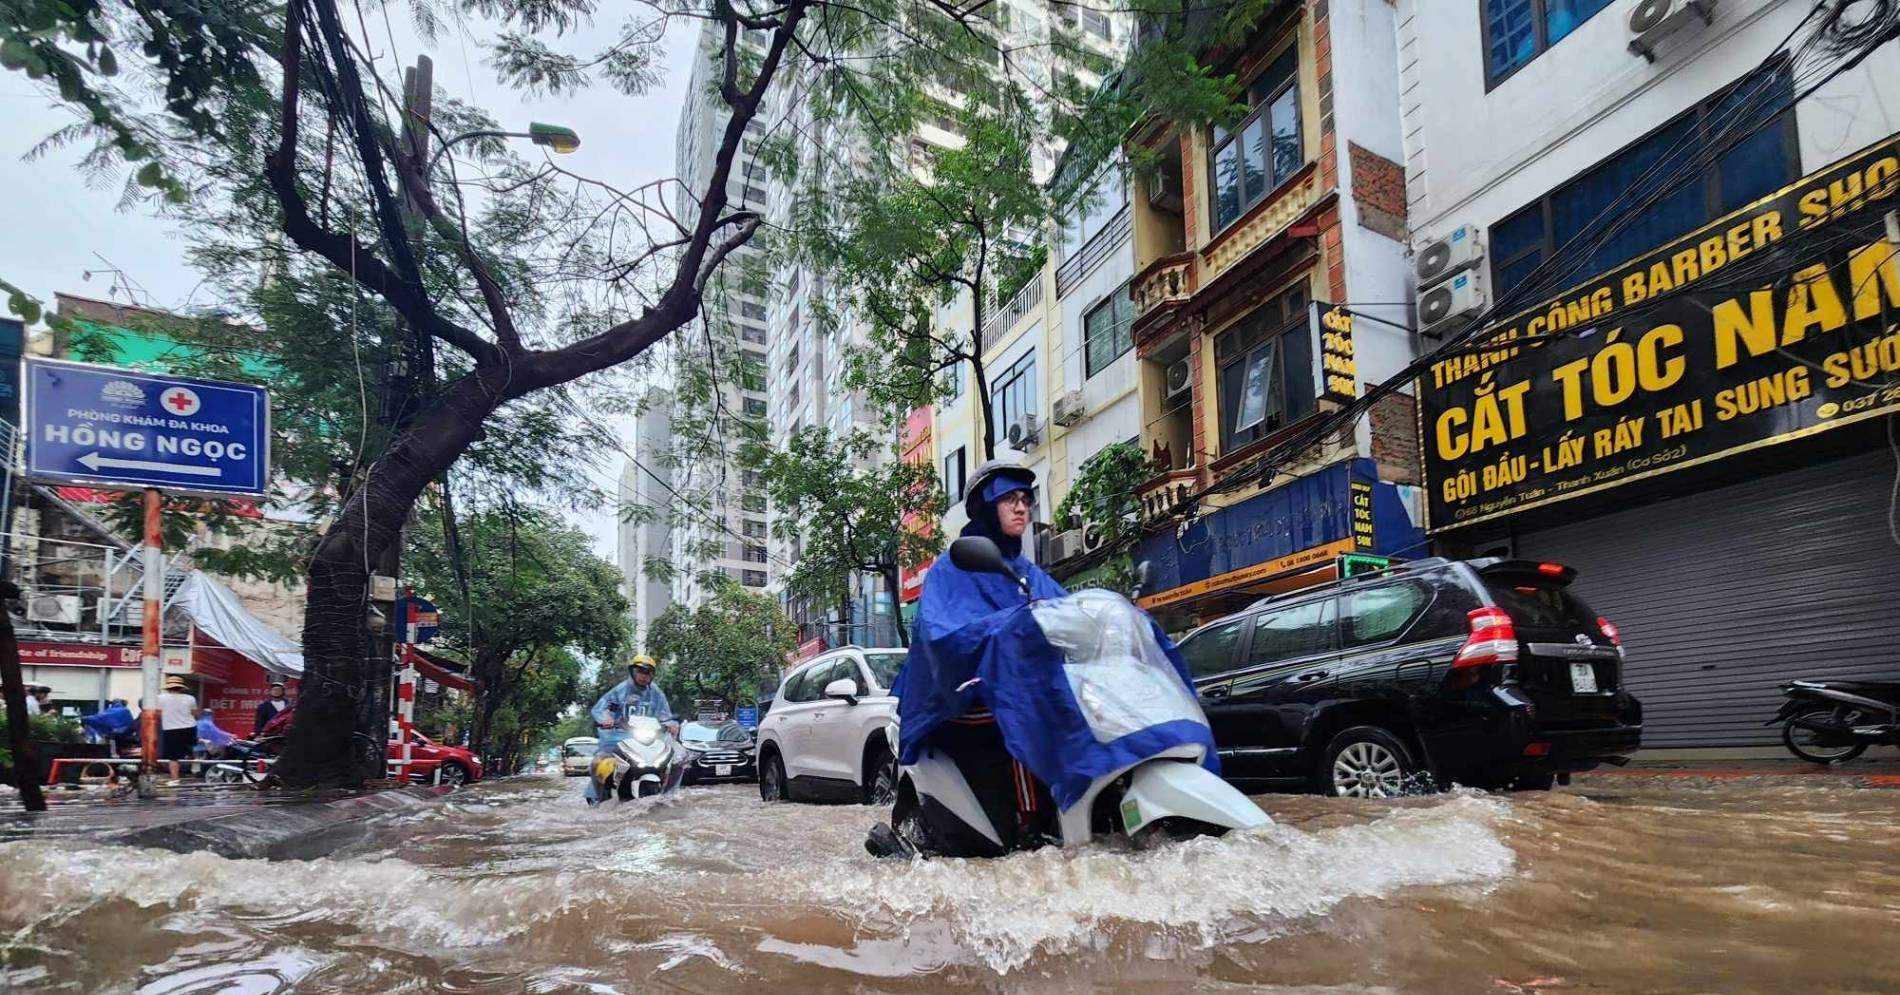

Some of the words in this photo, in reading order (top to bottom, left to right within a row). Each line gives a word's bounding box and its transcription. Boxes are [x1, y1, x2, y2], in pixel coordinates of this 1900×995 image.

[1527, 287, 1613, 347] CÔNG
[1622, 210, 1783, 306] BARBER
[45, 421, 145, 450] HỒNG
[156, 434, 247, 461] NGỌC
[68, 408, 121, 423] PHÒNG
[123, 414, 165, 427] KHÁM
[168, 419, 188, 430] ĐA
[191, 422, 229, 434] KHOA
[1435, 370, 1530, 461] CẮT
[1553, 324, 1687, 422] TÓC
[1442, 469, 1478, 505] GỘI
[1482, 451, 1527, 491] ĐẦU
[1543, 430, 1585, 474] LẤY
[1594, 415, 1646, 459] RÁY
[1656, 399, 1703, 439] TAI
[1715, 365, 1810, 421] SUNG
